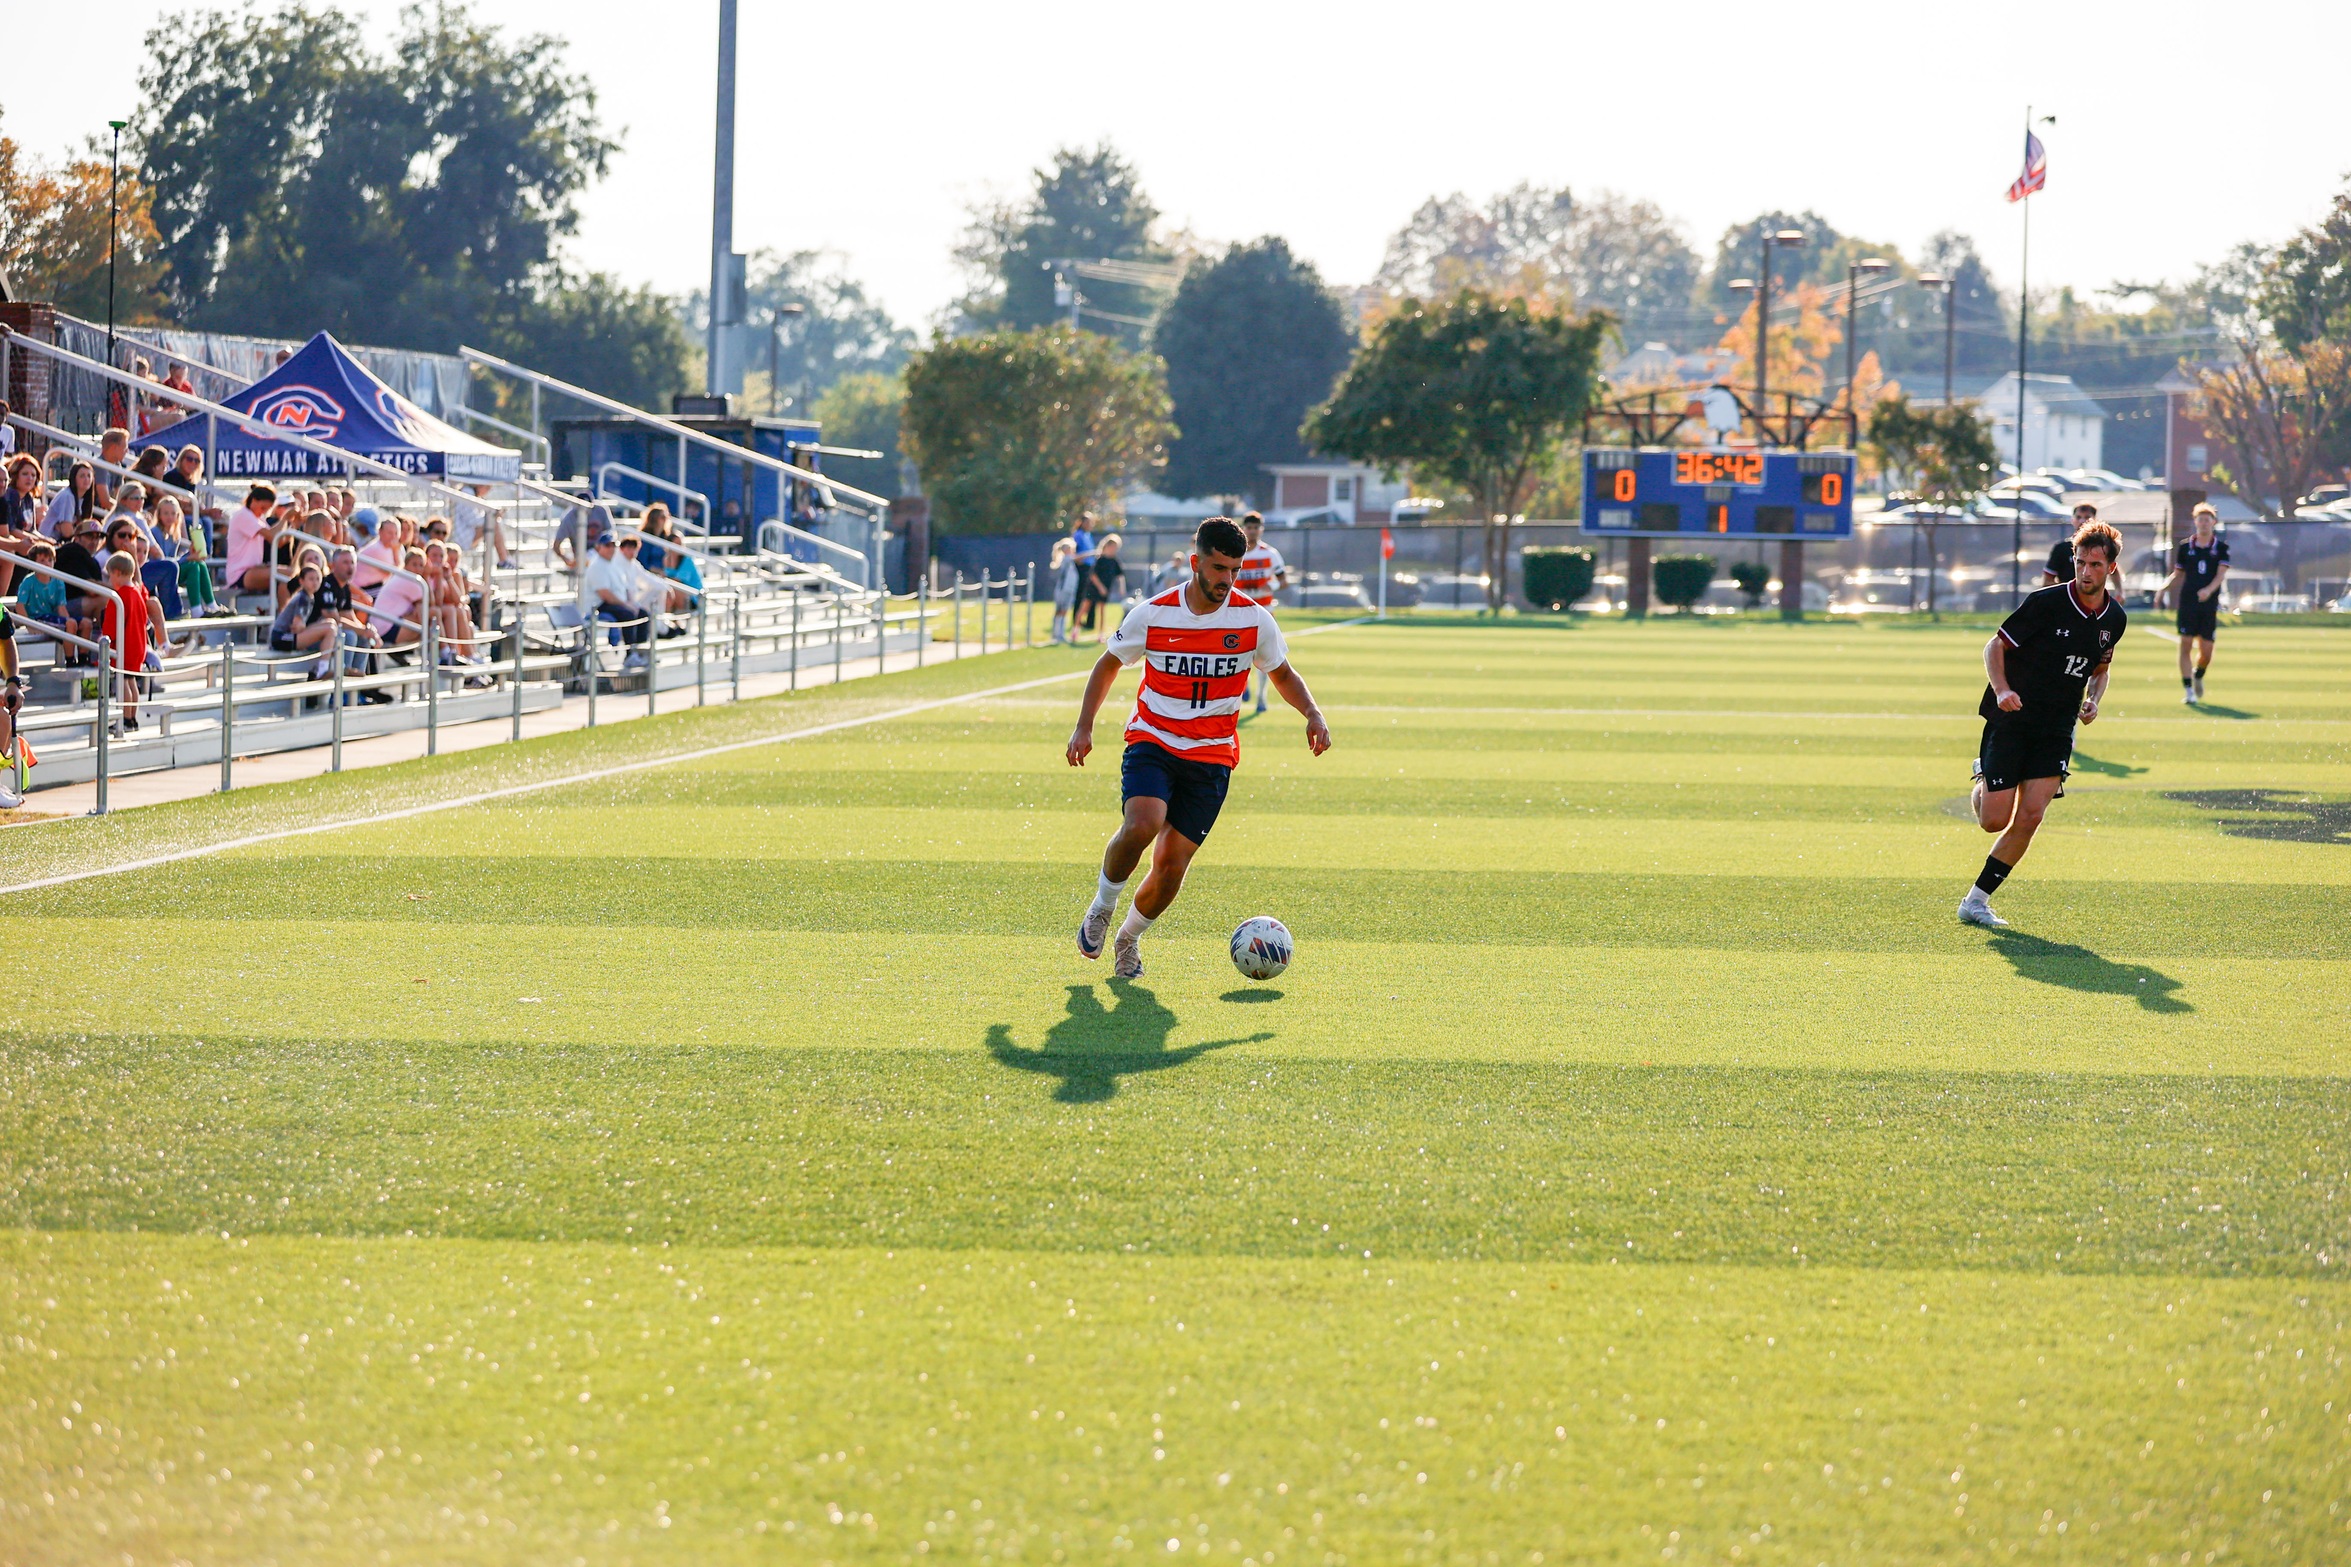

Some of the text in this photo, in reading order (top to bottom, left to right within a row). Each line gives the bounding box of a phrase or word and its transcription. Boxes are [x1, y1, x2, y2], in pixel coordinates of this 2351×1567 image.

[218, 450, 308, 473] NEWMAN
[316, 453, 428, 473] ATTICS
[1676, 452, 1763, 485] 36:42
[1615, 469, 1636, 502] 0
[1821, 473, 1842, 506] 0
[1719, 504, 1728, 533] 1
[1165, 656, 1239, 677] EAGLES
[2064, 654, 2089, 678] 12
[1190, 681, 1209, 709] 11
